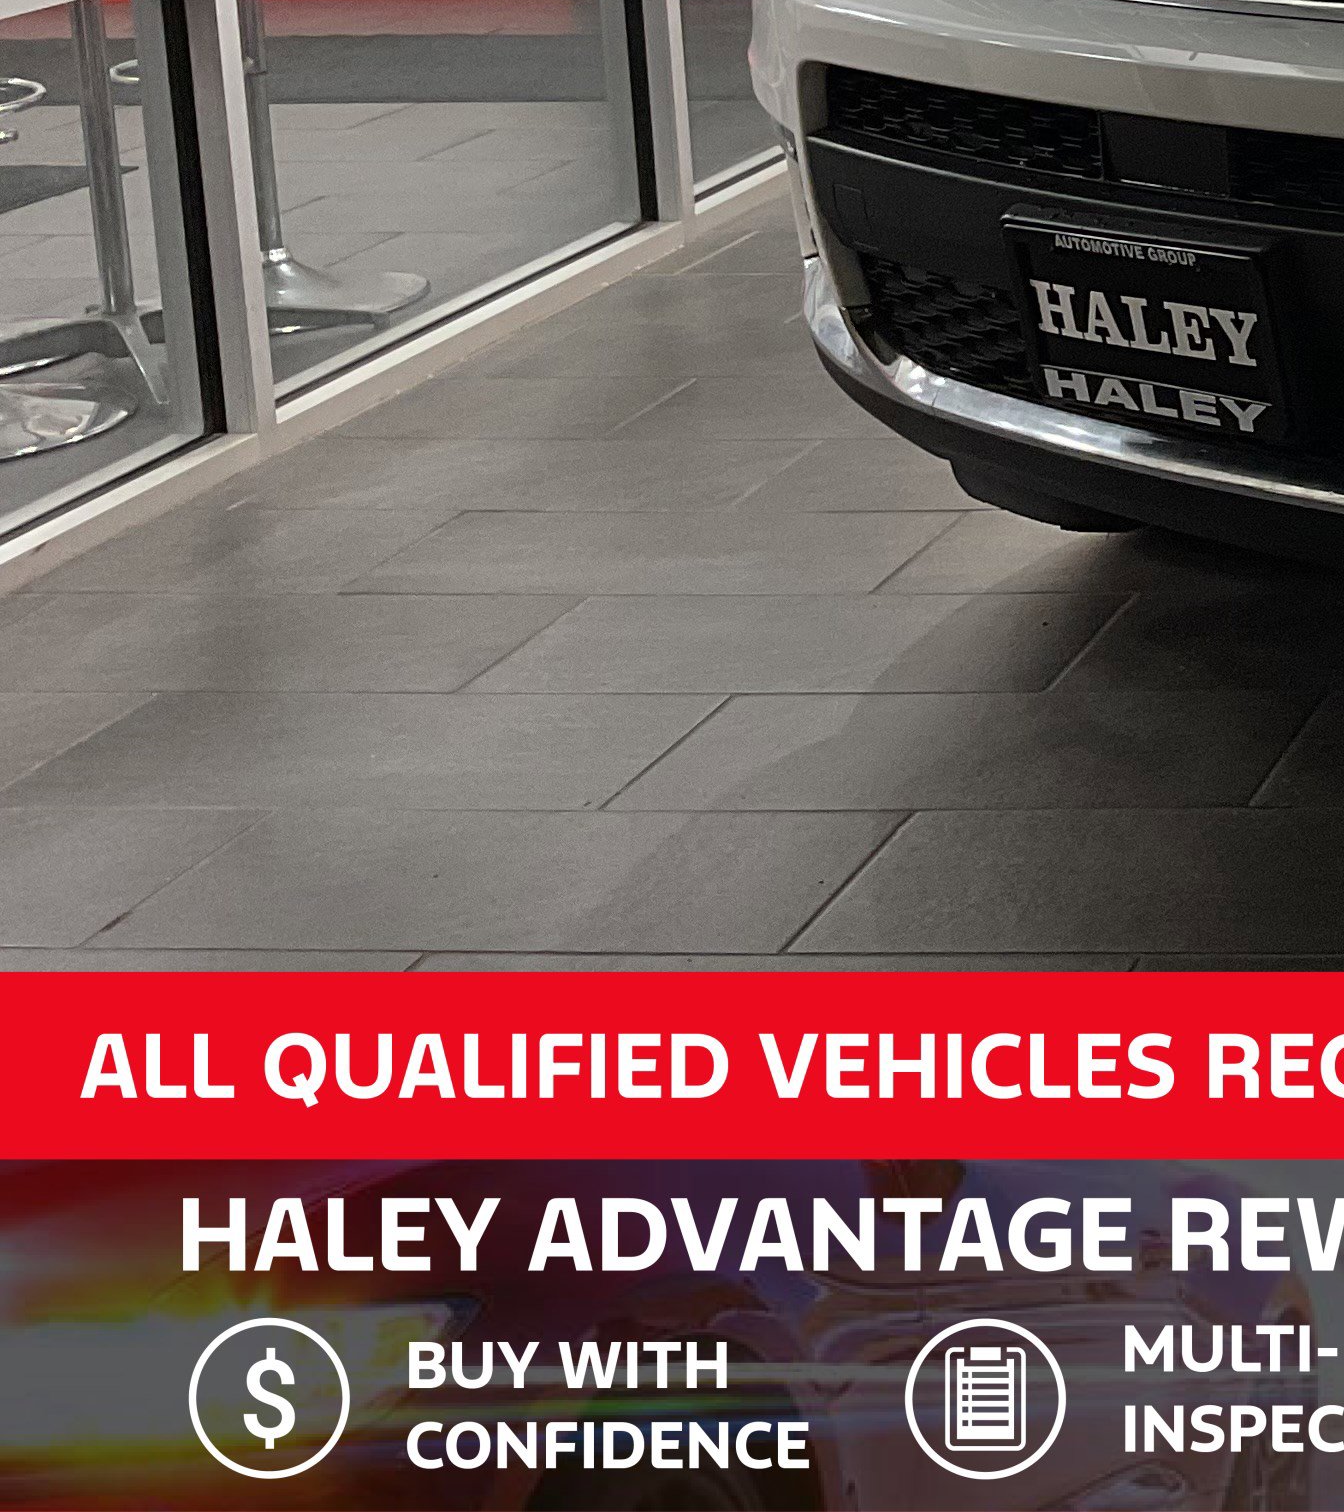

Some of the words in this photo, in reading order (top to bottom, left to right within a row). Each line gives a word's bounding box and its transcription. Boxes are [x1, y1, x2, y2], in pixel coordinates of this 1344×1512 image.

[1054, 233, 1145, 260] AUTOMOTIVE
[1148, 246, 1197, 267] GROUP
[1029, 278, 1258, 367] HALEY
[1043, 367, 1268, 433] HALEY
